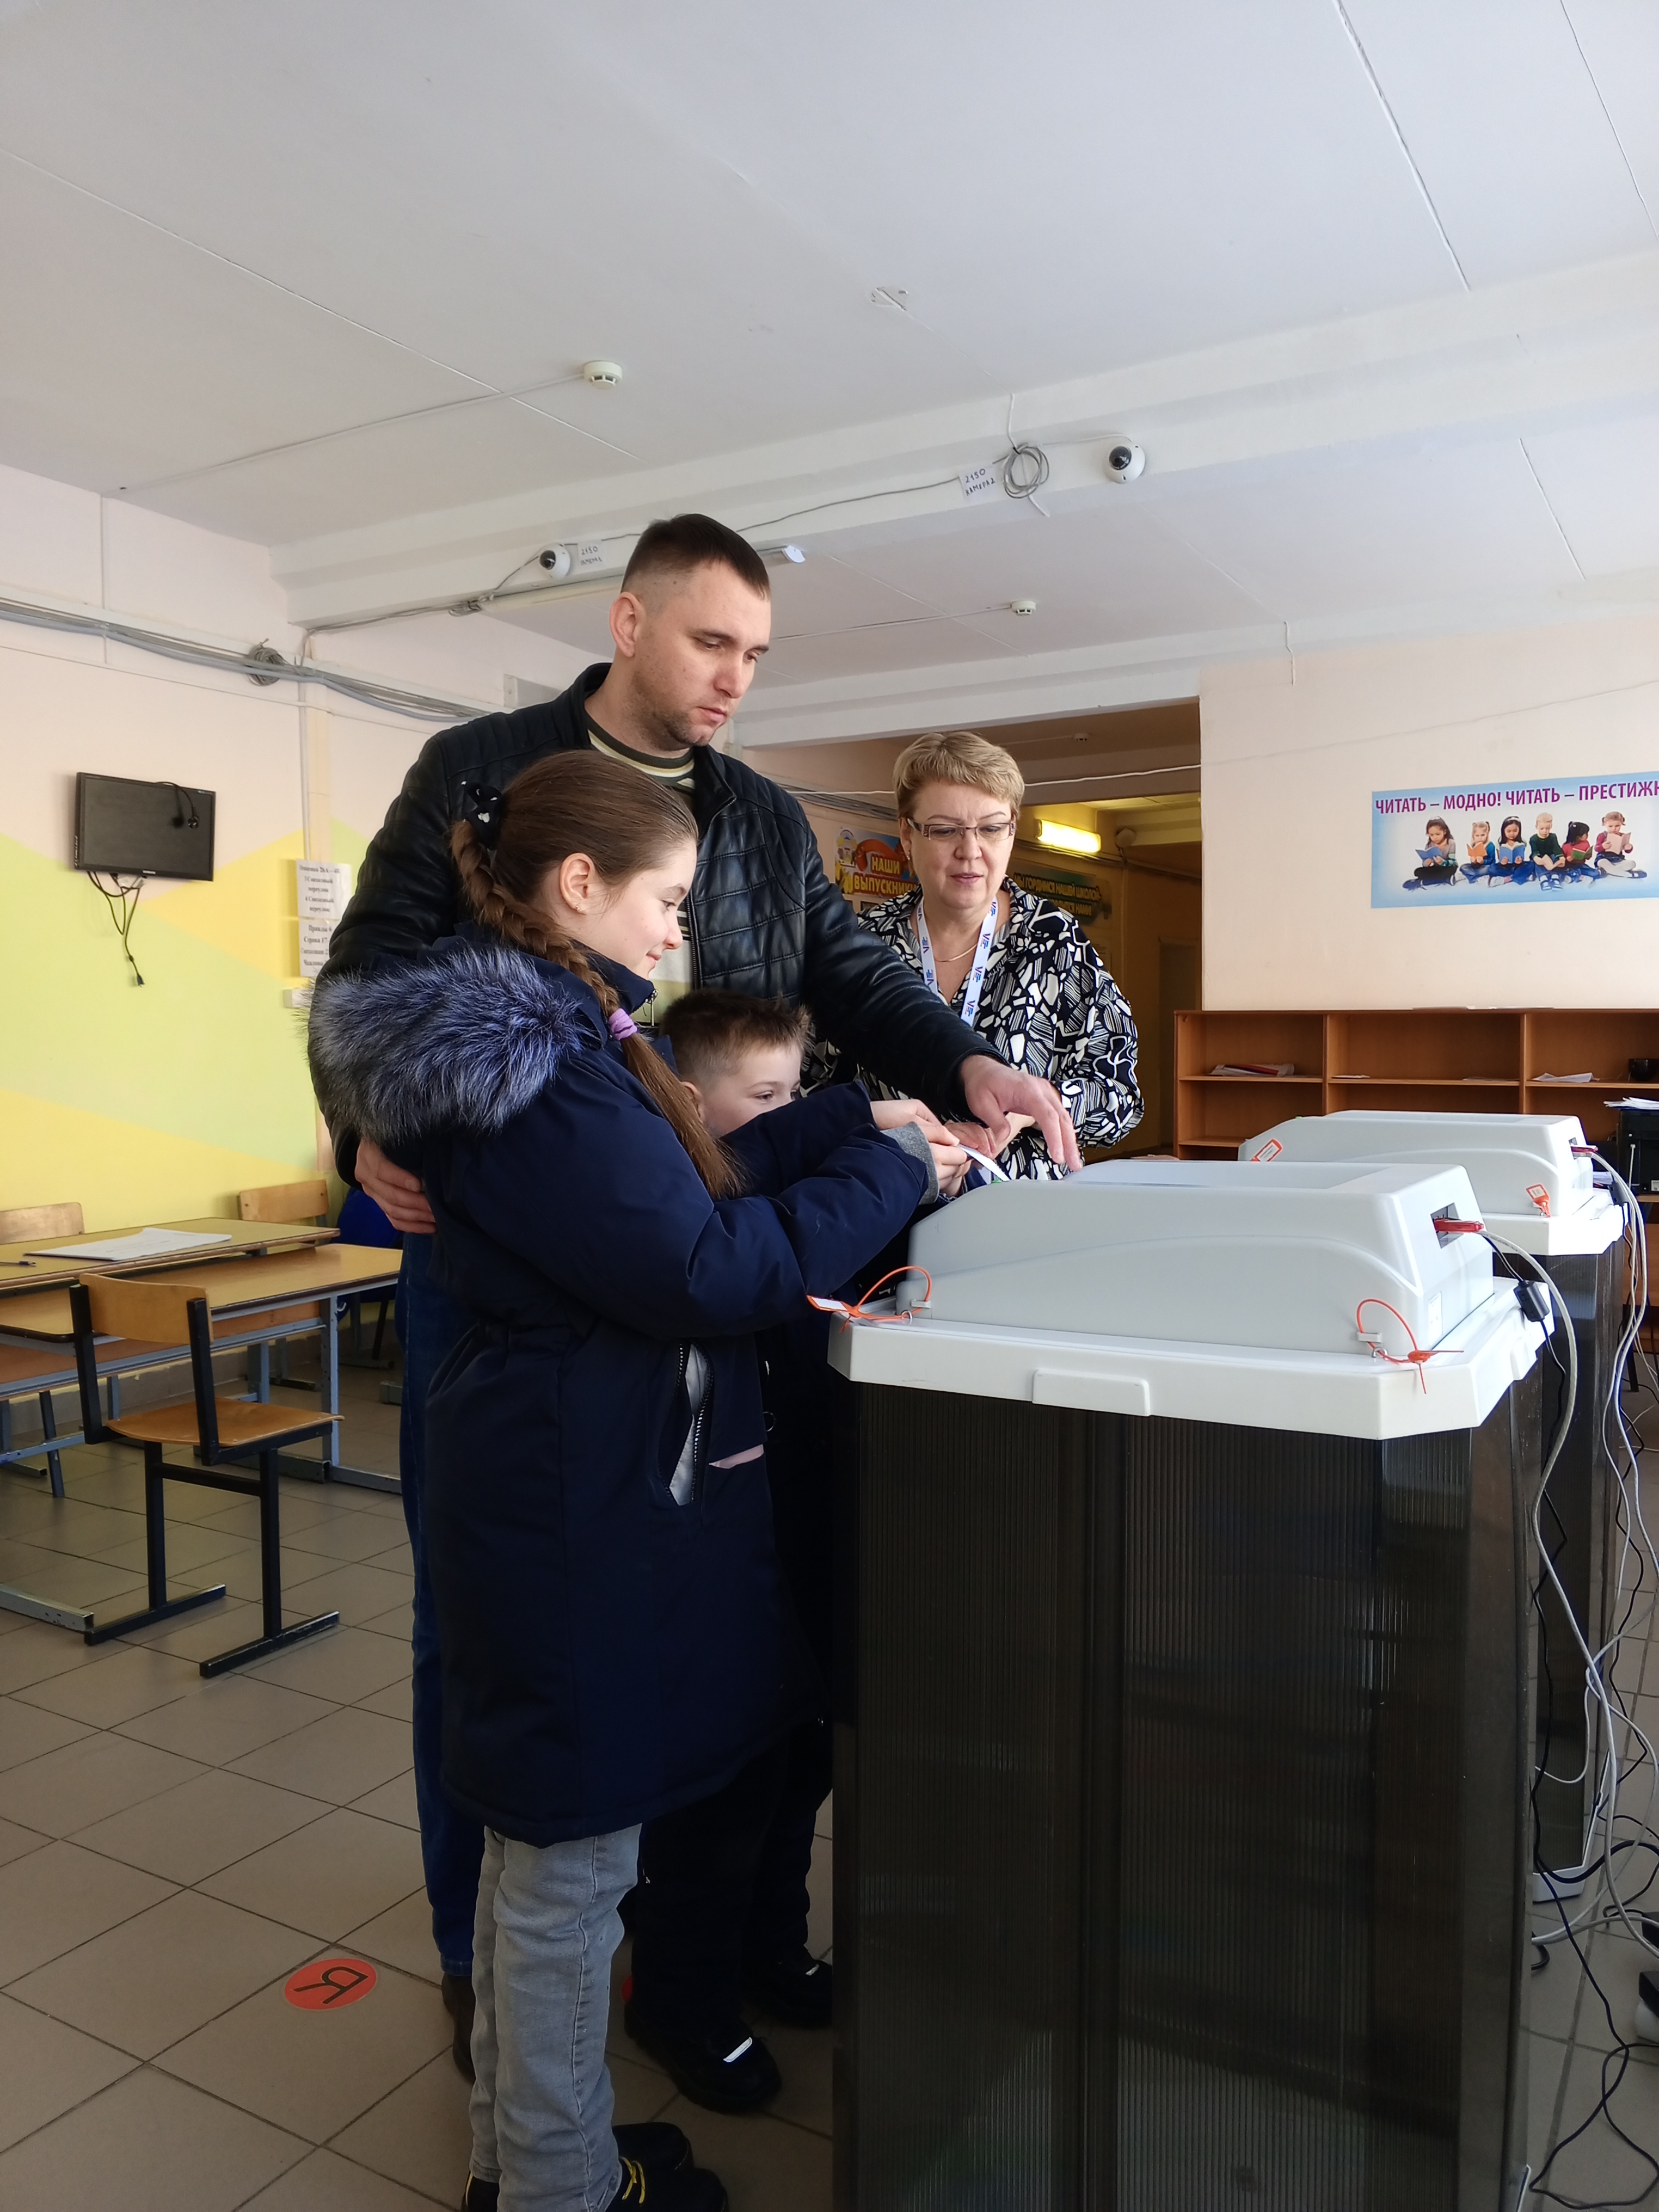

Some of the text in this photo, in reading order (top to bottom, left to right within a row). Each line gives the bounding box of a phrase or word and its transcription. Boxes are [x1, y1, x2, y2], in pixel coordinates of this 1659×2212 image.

[966, 468, 986, 483] 2150
[1375, 797, 1427, 814] ЧИТАТЬ
[1443, 791, 1501, 812] МОДНО!
[1506, 788, 1561, 806] ЧИТАТЬ
[871, 856, 900, 875] НАШИ
